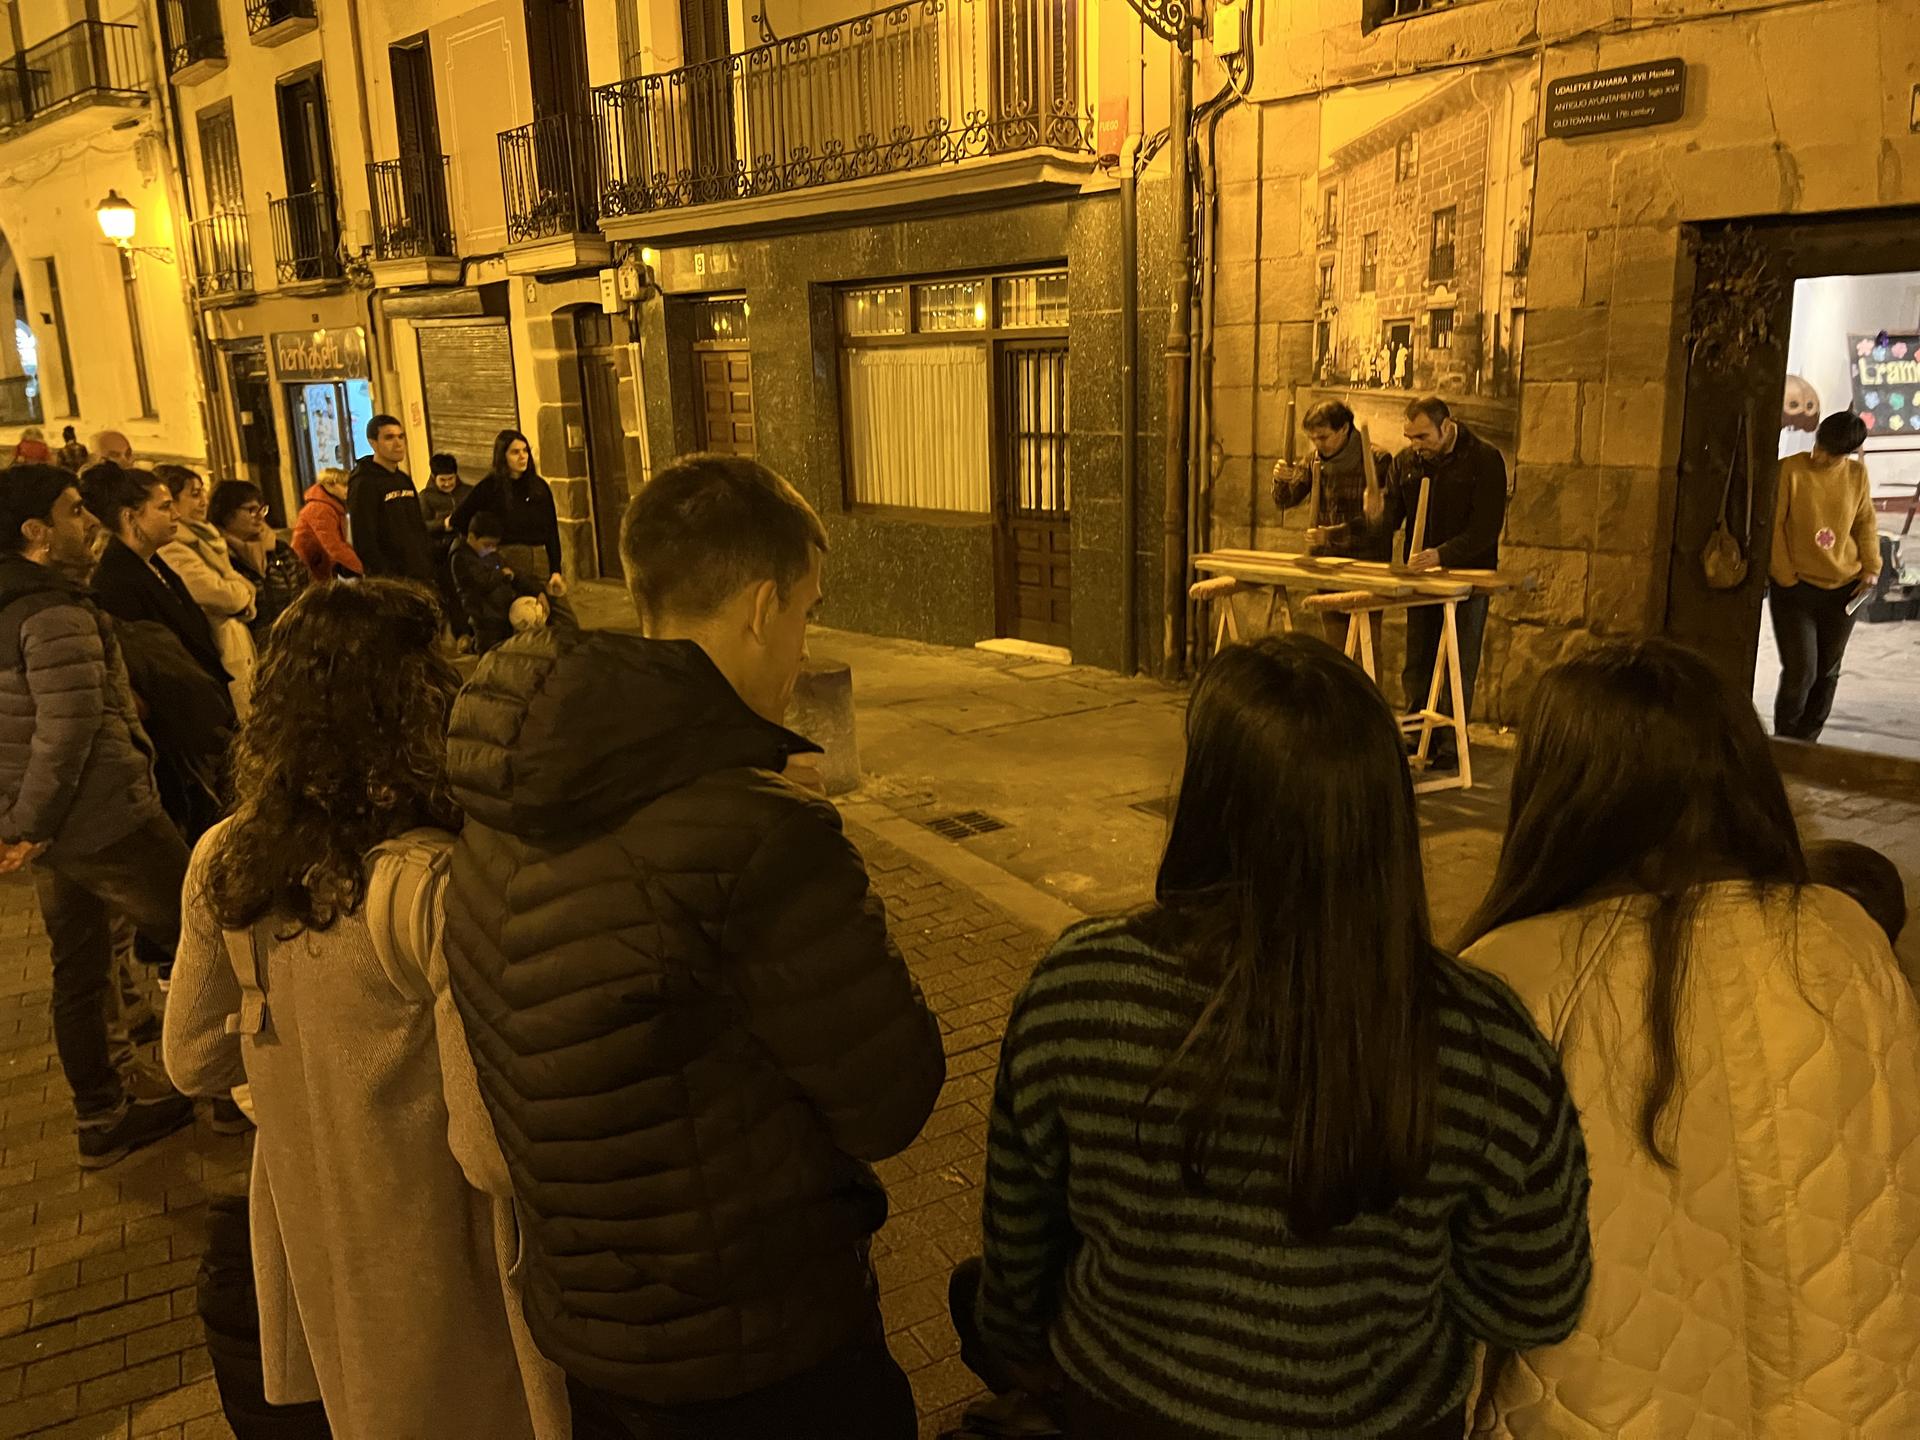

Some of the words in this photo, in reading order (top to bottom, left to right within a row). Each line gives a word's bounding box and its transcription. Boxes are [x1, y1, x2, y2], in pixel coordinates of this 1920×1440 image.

[1554, 81, 1592, 96] UDALETXE
[1592, 75, 1628, 89] ZAHARRA
[1553, 100, 1588, 112] ANTIGUO
[1588, 90, 1645, 108] AYUNTAMIENTO
[1553, 117, 1569, 129] OLD
[1569, 114, 1592, 126] TOWN
[1593, 112, 1611, 123] HALL
